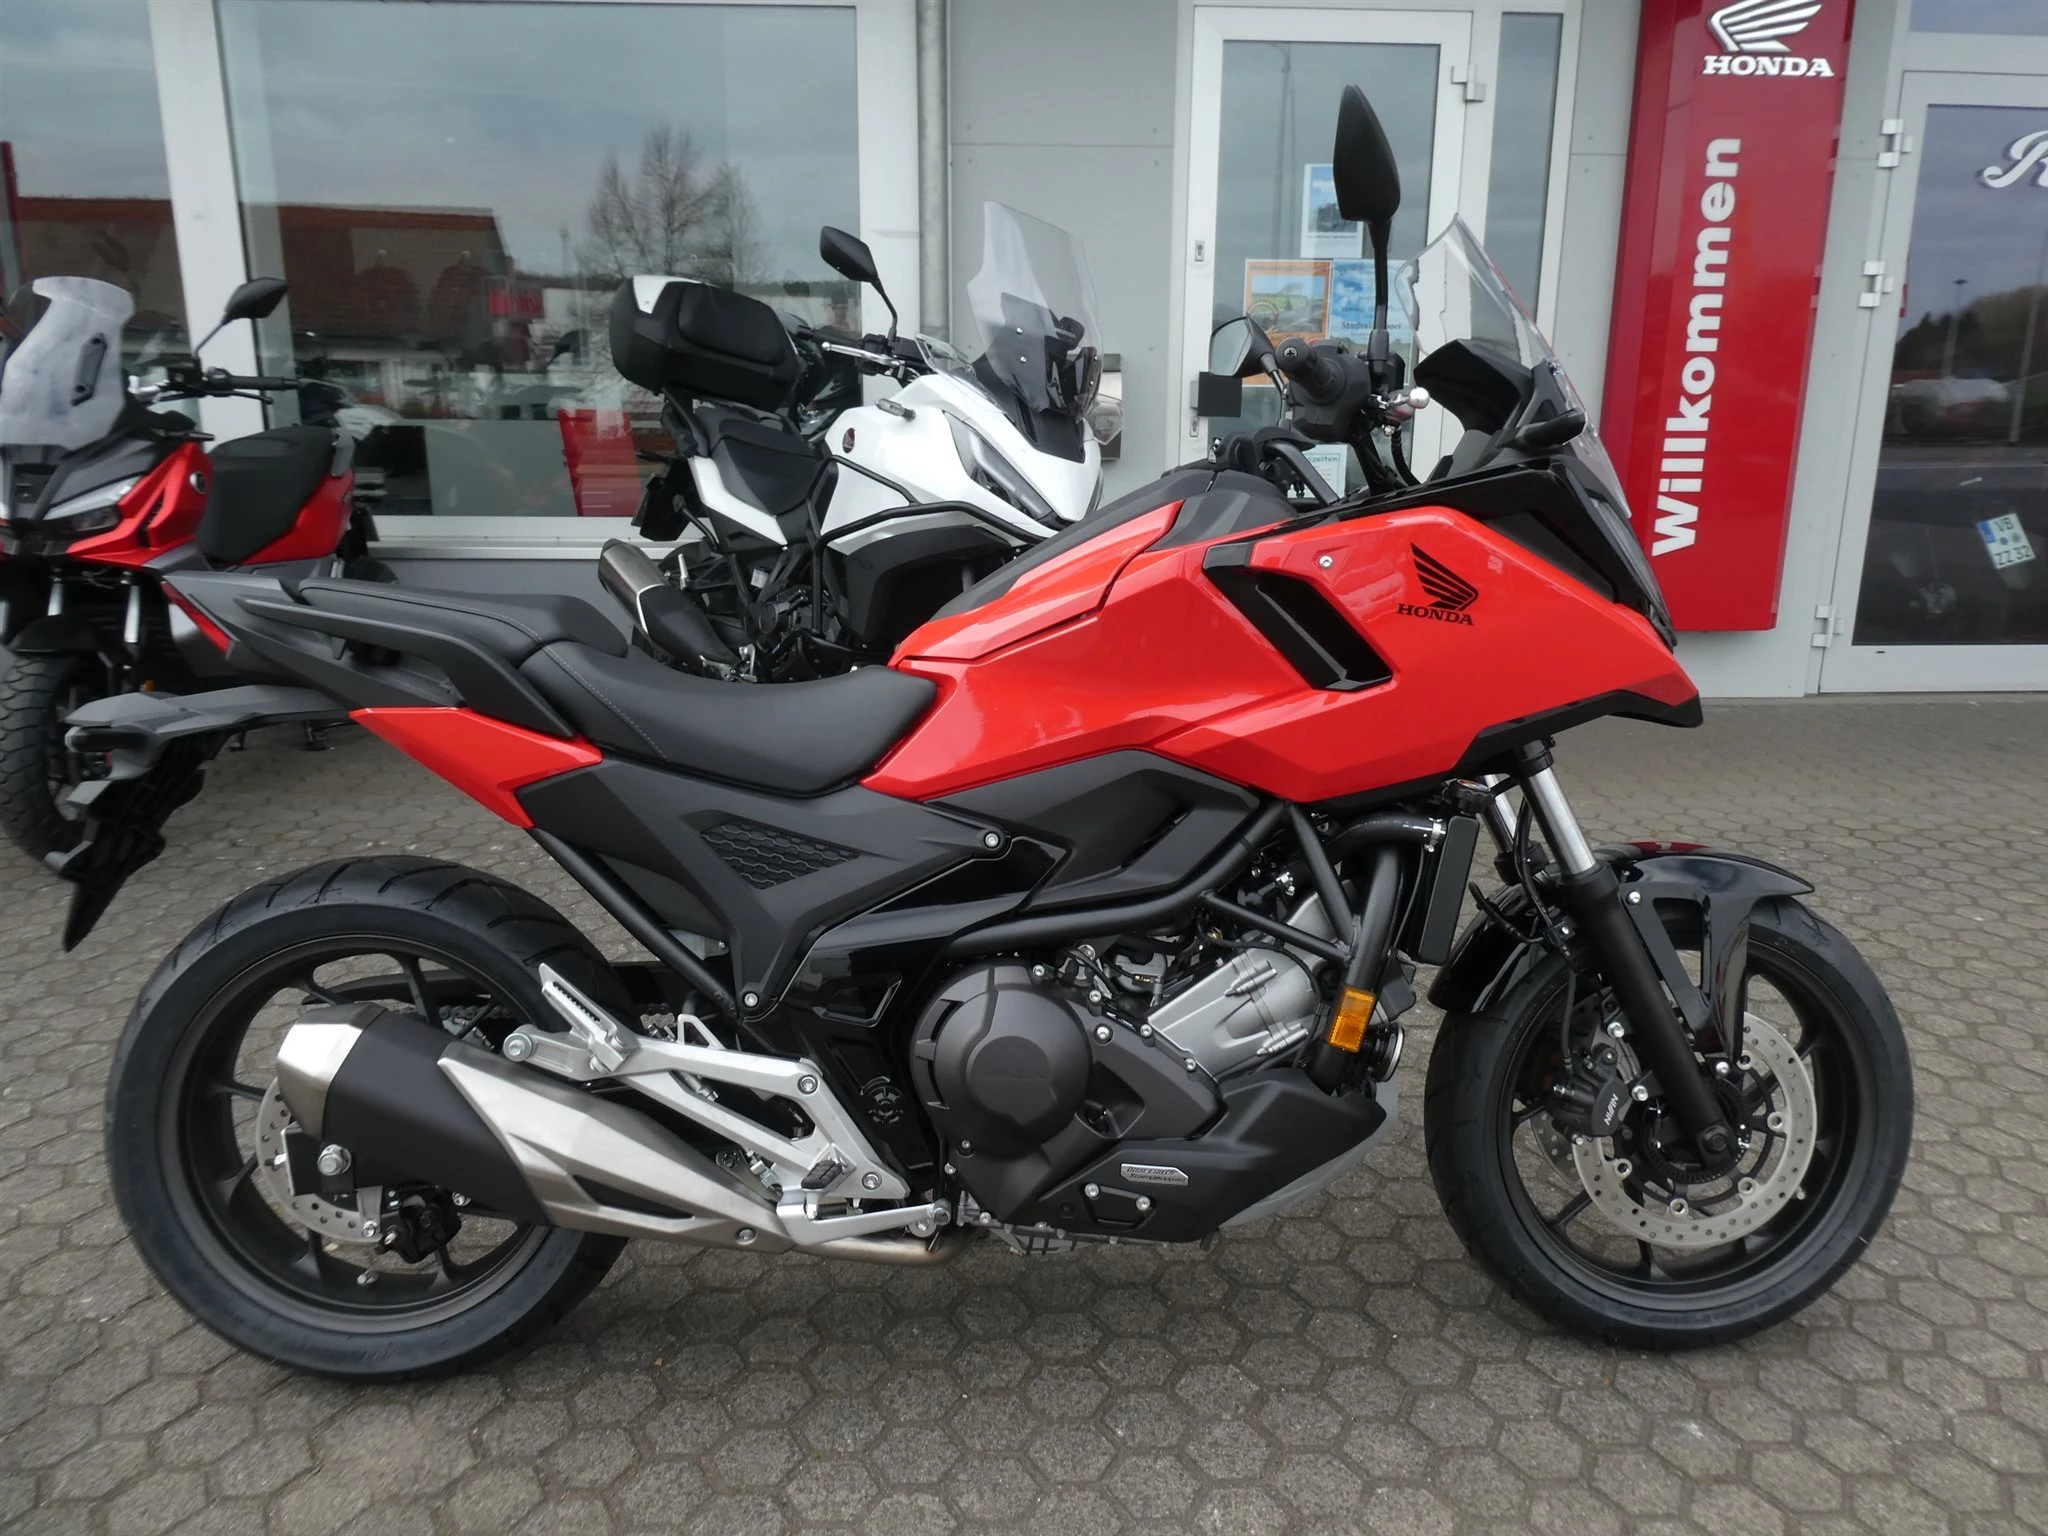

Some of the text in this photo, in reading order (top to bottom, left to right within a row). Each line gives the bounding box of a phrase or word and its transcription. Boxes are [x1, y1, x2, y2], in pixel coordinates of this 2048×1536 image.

[1702, 55, 1835, 78] HONDA
[1652, 137, 1741, 557] Willkommen
[1396, 602, 1475, 626] HONDA
